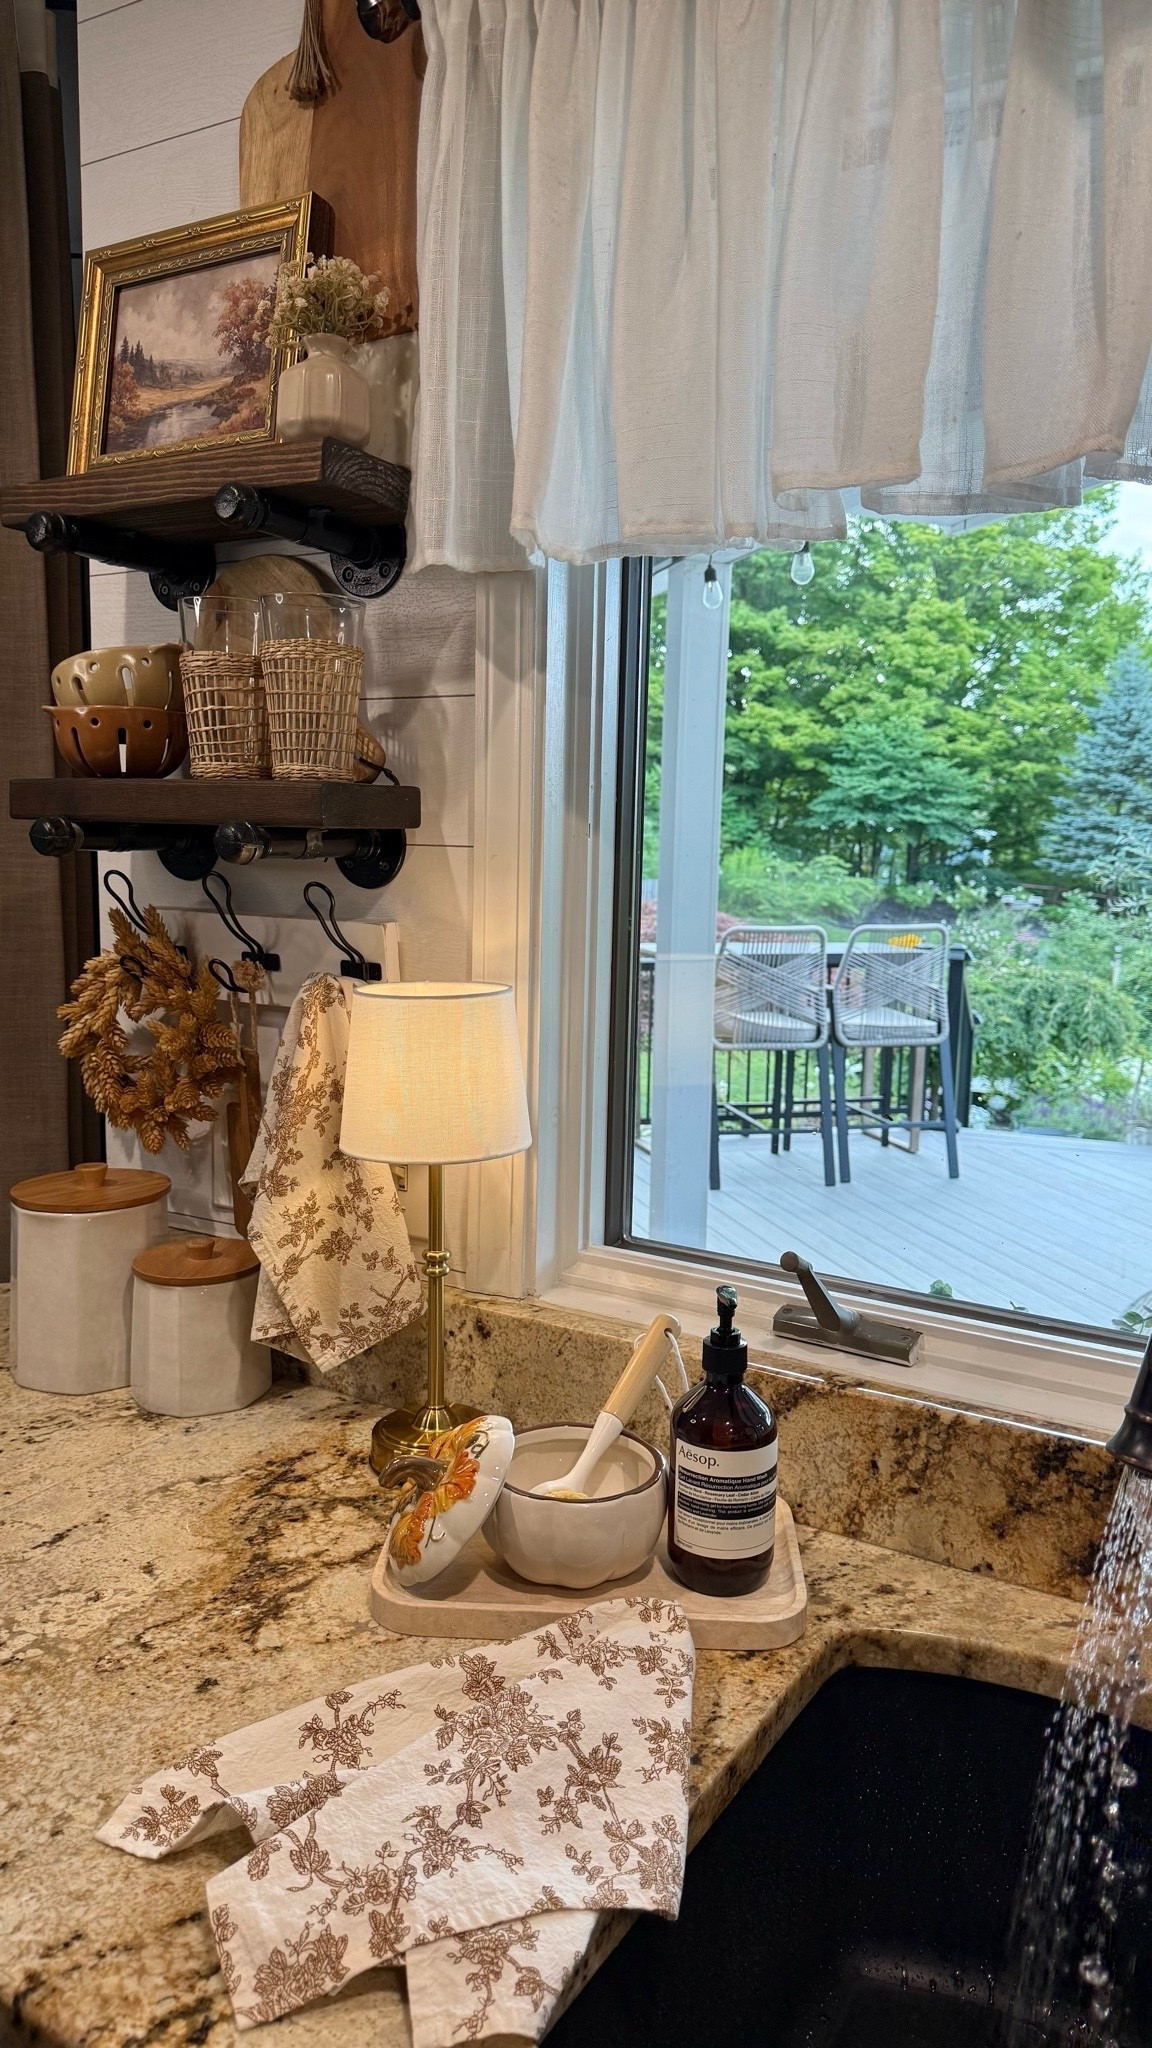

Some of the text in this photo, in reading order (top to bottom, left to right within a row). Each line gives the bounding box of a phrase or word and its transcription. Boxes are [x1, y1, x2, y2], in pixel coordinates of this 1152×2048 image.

[710, 1477, 742, 1485] Aromatique
[757, 1473, 768, 1481] Wash
[734, 1482, 761, 1491] Aromatique
